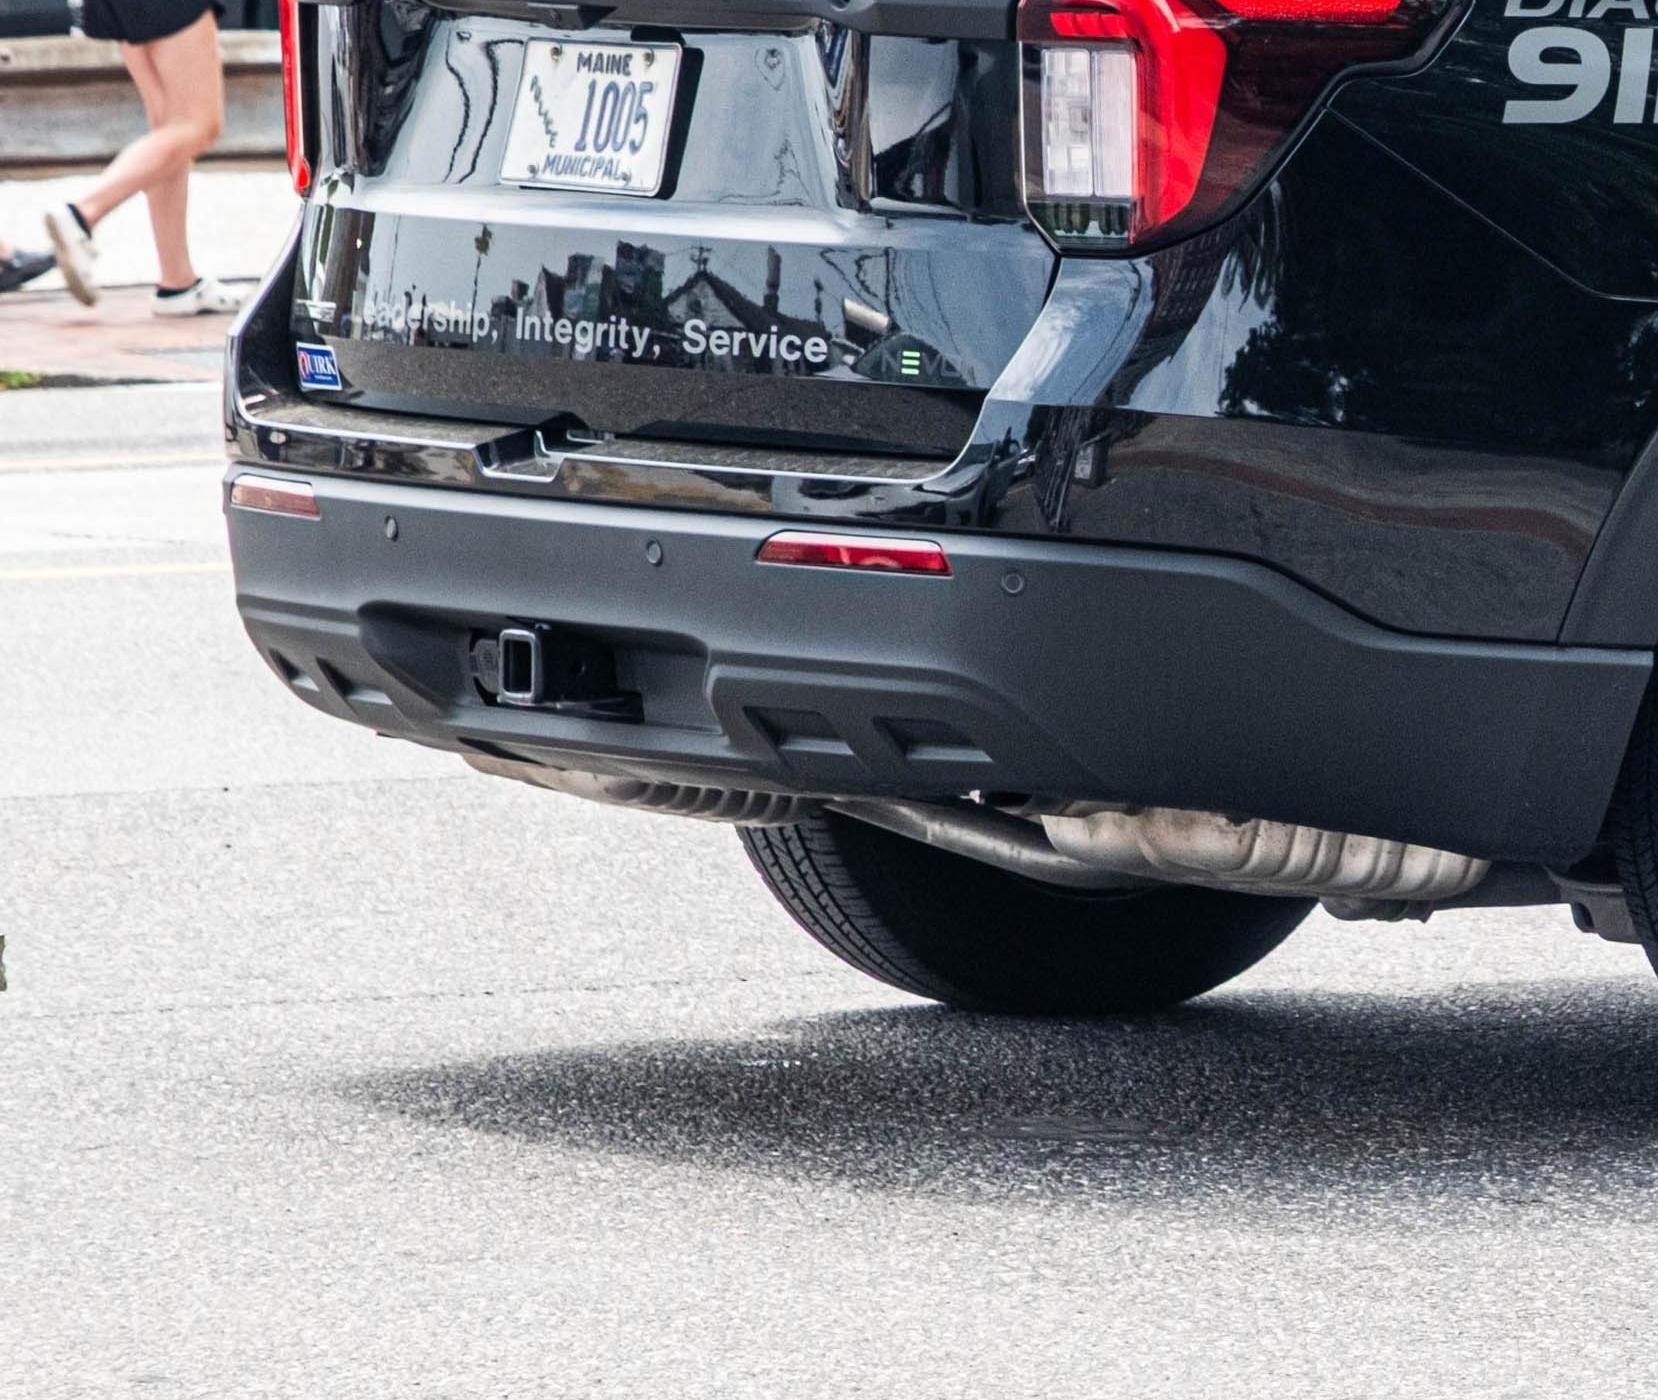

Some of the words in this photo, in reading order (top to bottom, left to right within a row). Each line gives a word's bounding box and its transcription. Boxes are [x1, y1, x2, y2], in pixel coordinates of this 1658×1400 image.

[576, 52, 633, 76] MAINE
[574, 78, 654, 155] 1005
[542, 153, 622, 181] MUNICIPAL
[515, 306, 661, 361] Integrity,
[682, 318, 828, 363] Service
